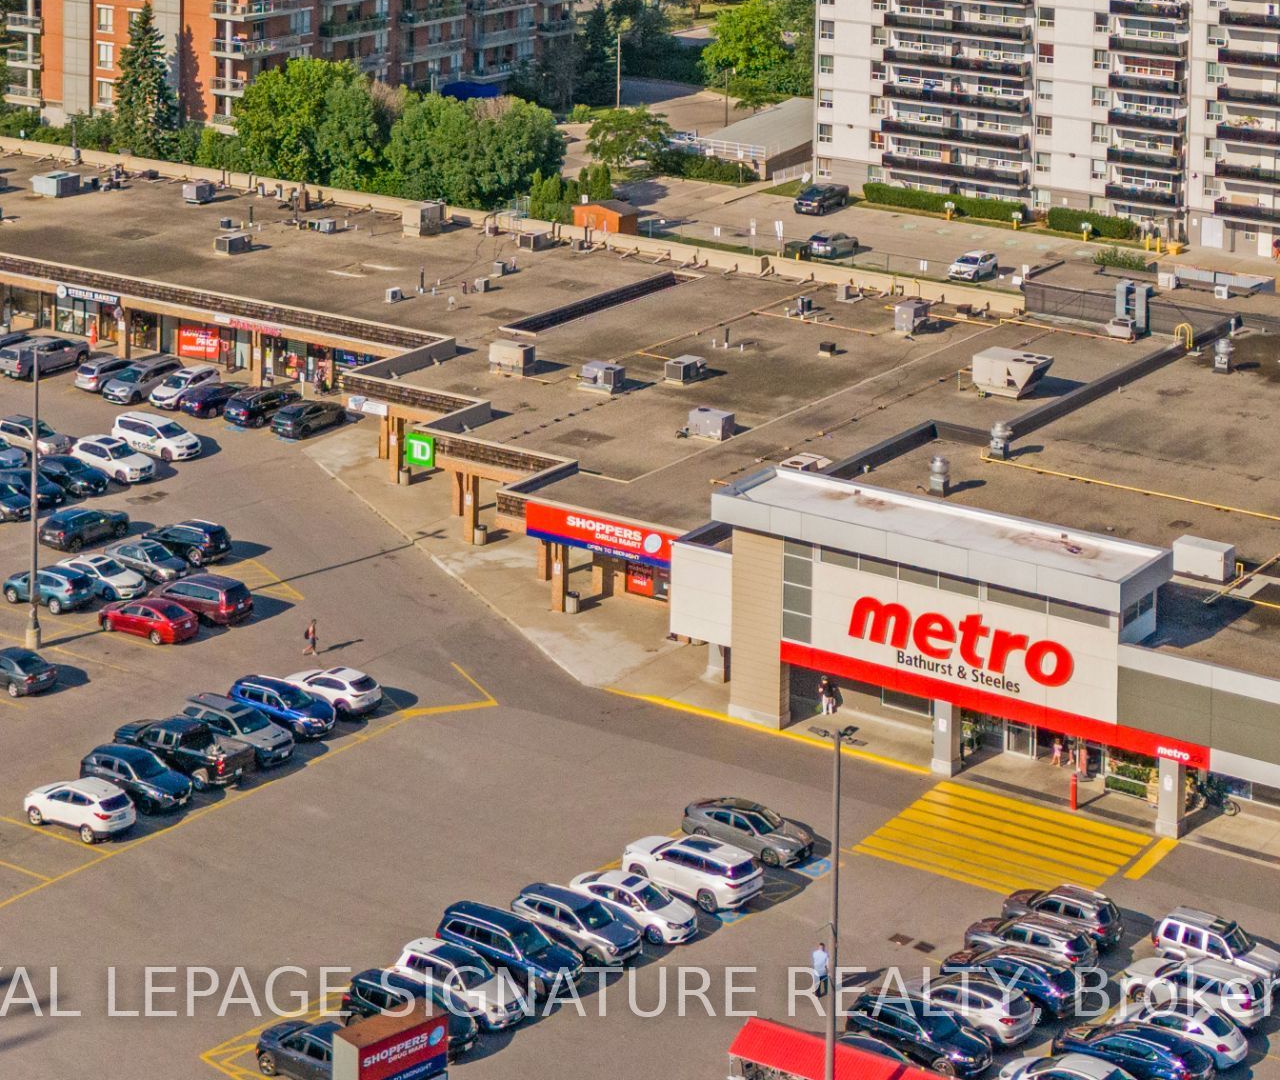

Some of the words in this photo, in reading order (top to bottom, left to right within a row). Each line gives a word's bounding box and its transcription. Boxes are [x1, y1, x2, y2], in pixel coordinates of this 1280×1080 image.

[94, 292, 118, 305] BAKERY
[409, 439, 430, 461] TD
[566, 516, 642, 541] SHOPPERS
[595, 532, 617, 543] DRUG
[619, 537, 642, 549] MART
[587, 544, 602, 553] OPEN
[604, 547, 612, 555] TO
[613, 550, 639, 560] MIDNIGHT
[848, 595, 1075, 688] metro
[897, 649, 953, 677] Bathurst
[957, 663, 968, 681] &
[971, 669, 1021, 694] Steeles
[363, 1033, 428, 1067] SHOPPERS
[388, 1050, 408, 1064] DRUG
[408, 1042, 428, 1056] MART
